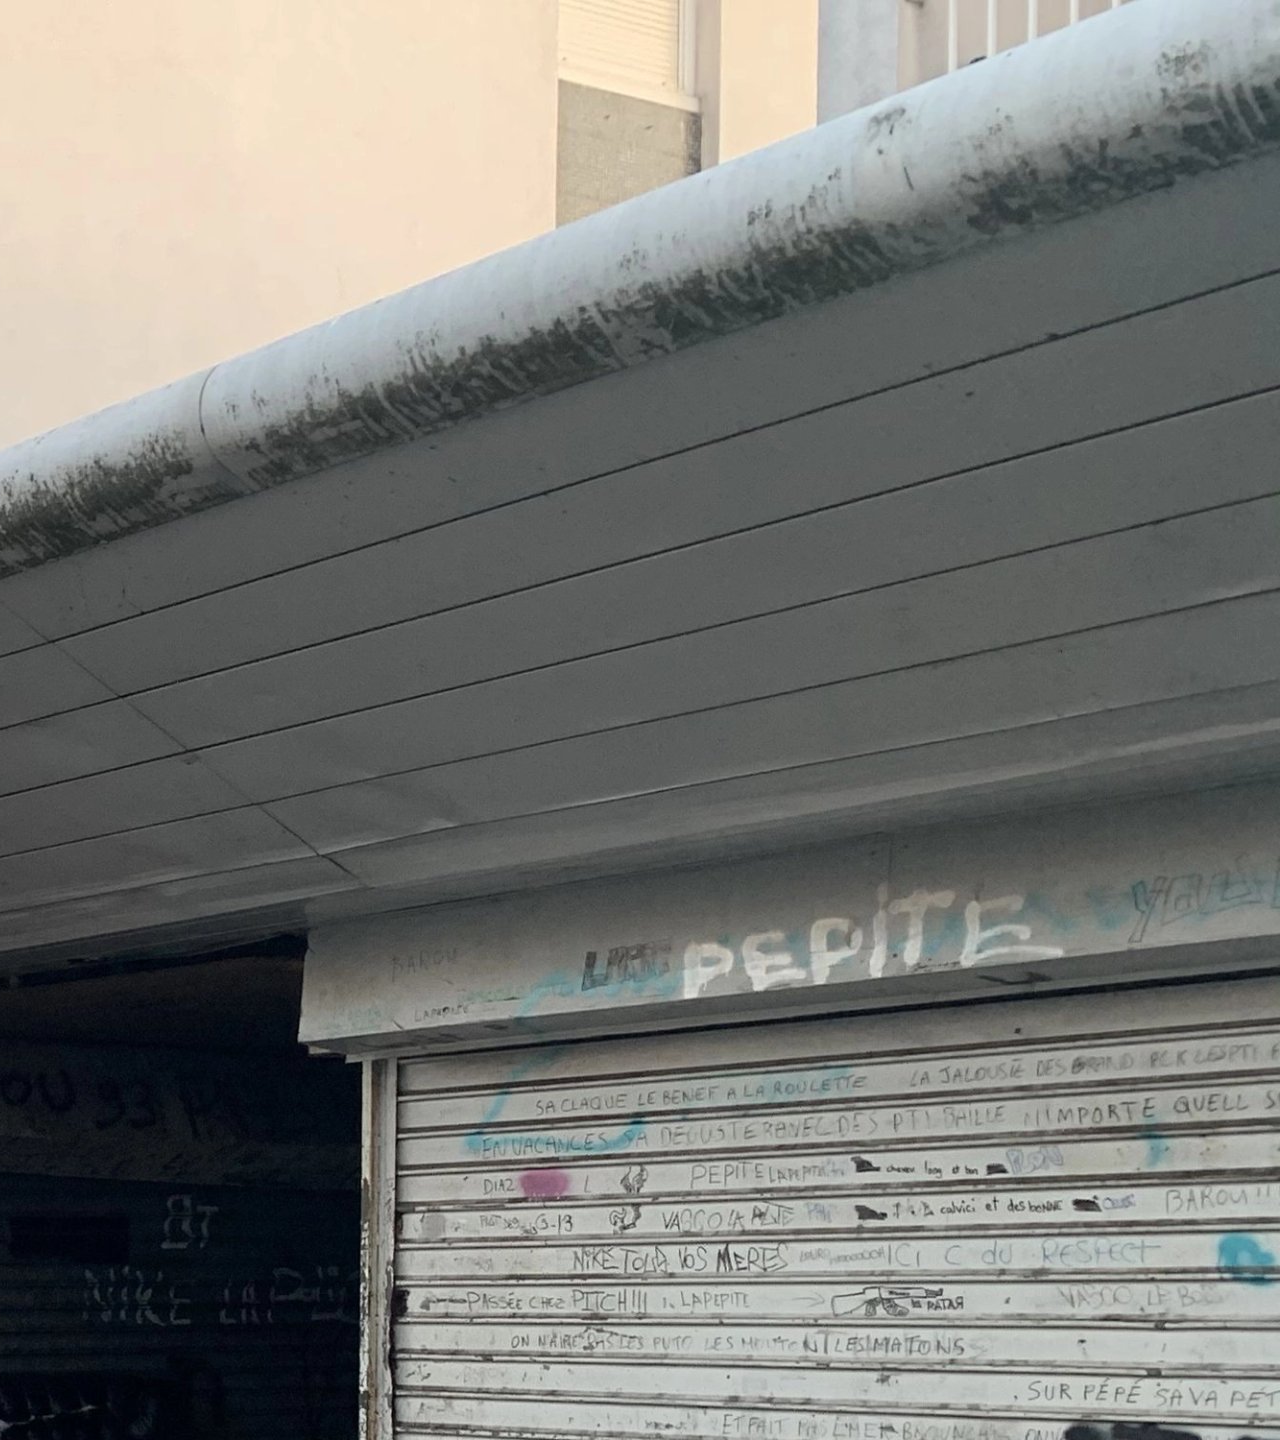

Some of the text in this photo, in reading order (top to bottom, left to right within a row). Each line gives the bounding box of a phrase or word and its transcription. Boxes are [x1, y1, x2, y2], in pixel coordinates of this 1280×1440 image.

[683, 884, 1064, 998] PEPITE
[772, 1074, 868, 1097] ROULETTE
[690, 1160, 764, 1189] PEPITE
[1027, 1379, 1072, 1402] SUR
